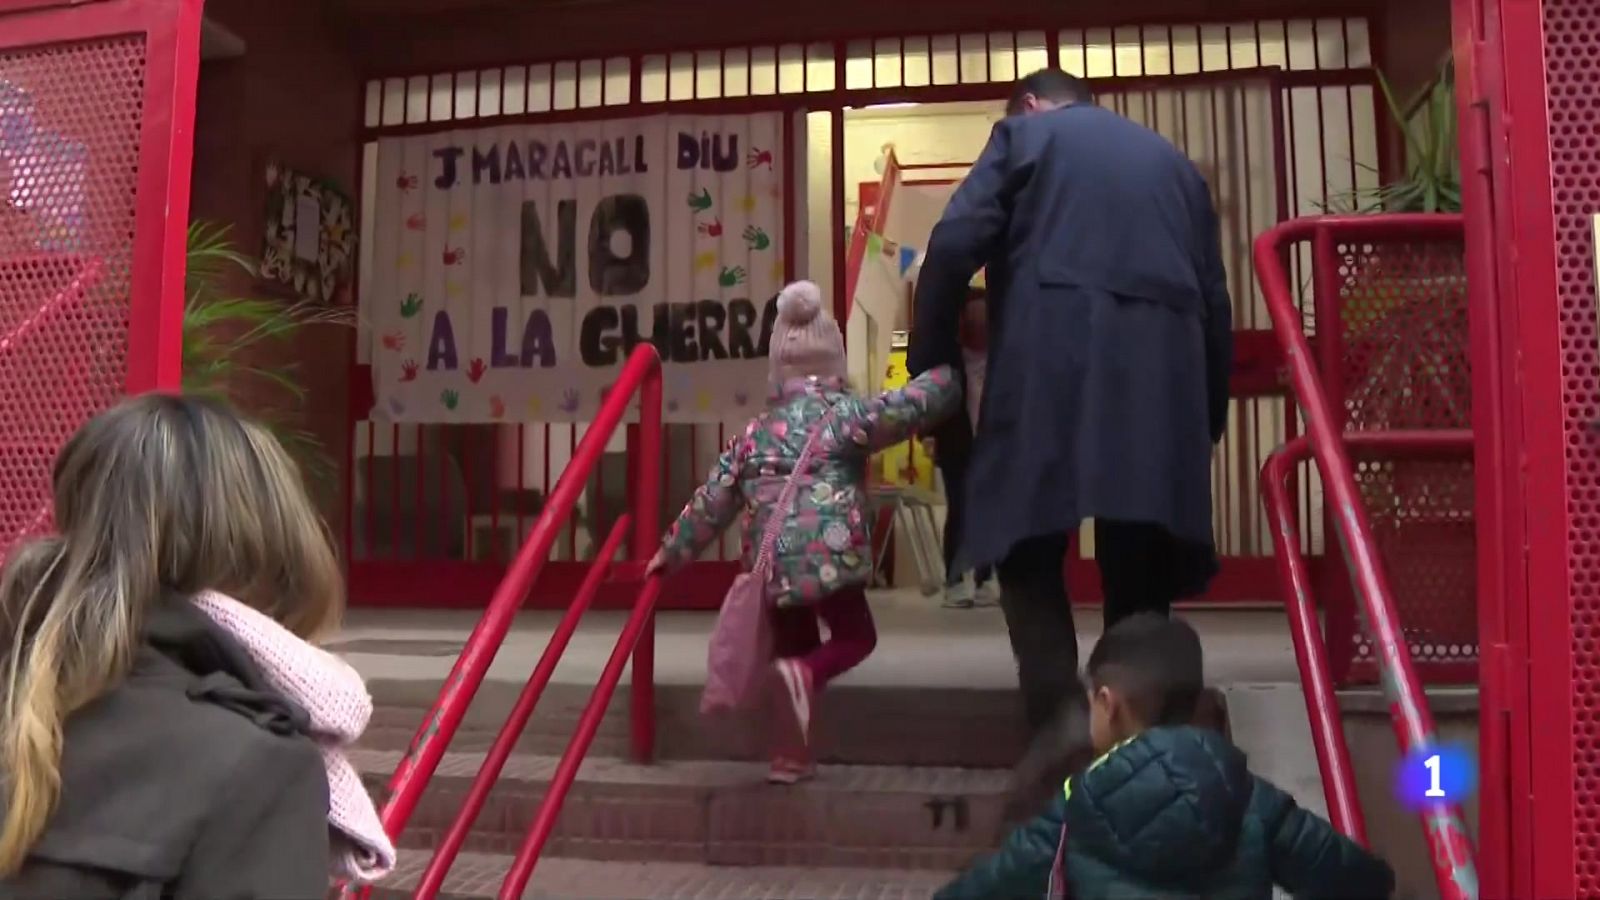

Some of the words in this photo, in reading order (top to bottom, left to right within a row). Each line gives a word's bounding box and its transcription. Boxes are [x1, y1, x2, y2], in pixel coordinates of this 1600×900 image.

[472, 135, 649, 185] MARAGALL
[520, 194, 650, 298] NO
[427, 310, 457, 370] A
[491, 307, 556, 369] LA
